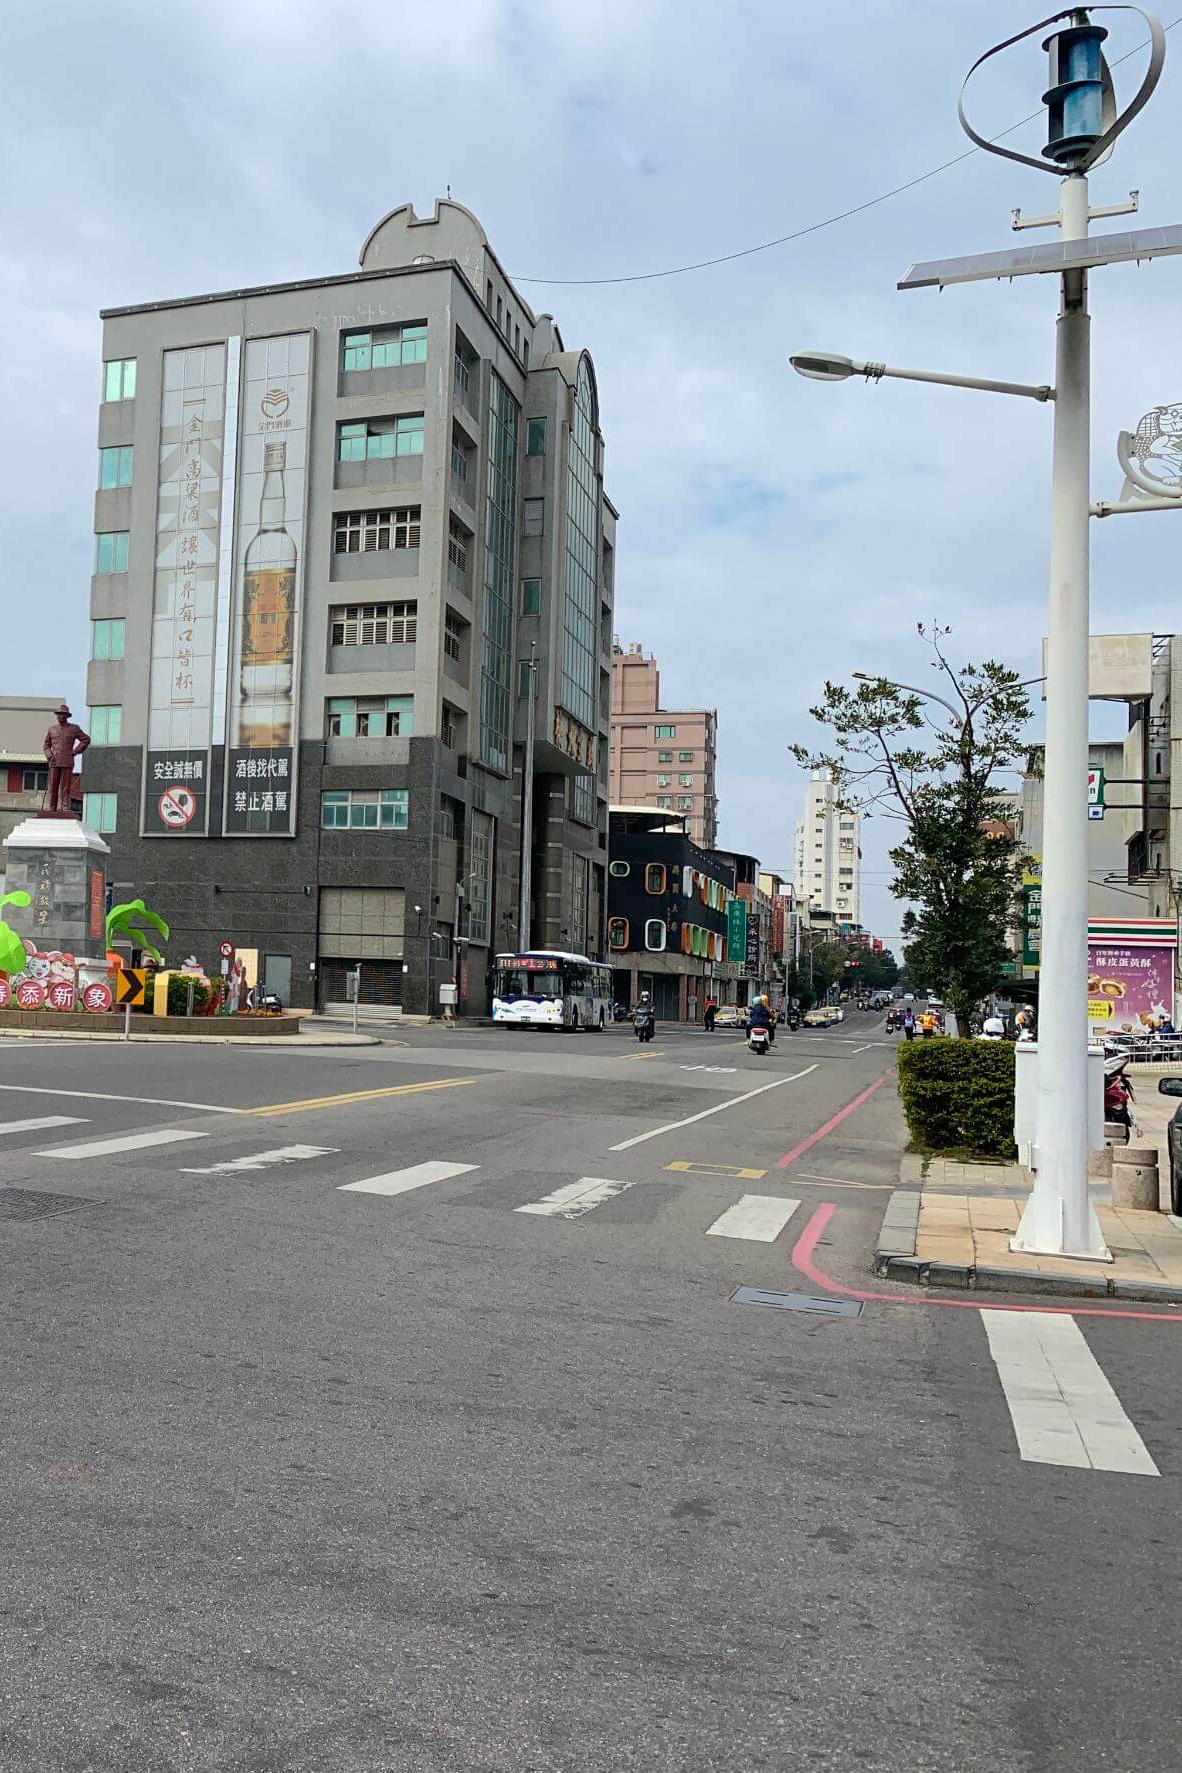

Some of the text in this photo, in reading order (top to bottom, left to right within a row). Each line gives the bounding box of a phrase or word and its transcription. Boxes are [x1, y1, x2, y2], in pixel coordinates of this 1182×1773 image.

[235, 758, 288, 778] 酒後找代駕
[235, 791, 287, 812] 禁止酒駕
[1095, 957, 1152, 968] 酥皮蛋黃酥
